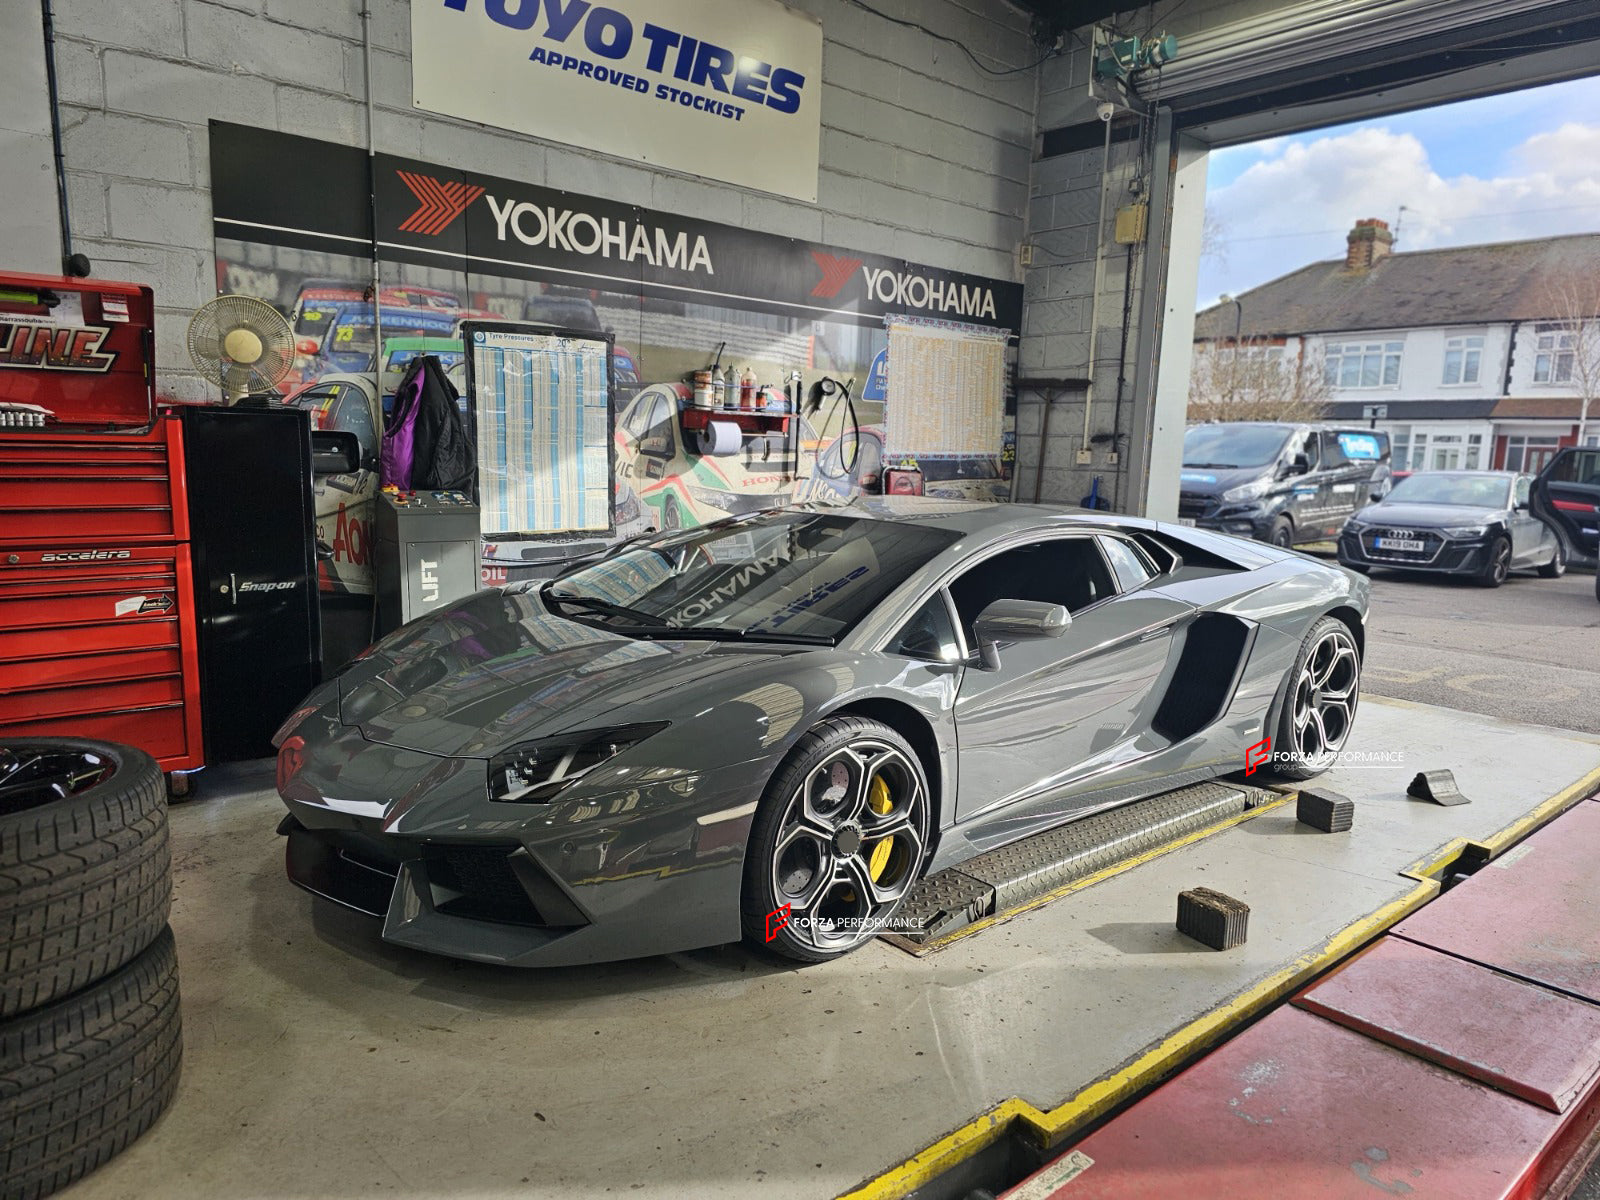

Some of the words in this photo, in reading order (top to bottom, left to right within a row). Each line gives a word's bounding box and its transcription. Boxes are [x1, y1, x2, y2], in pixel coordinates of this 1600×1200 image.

[444, 0, 634, 60] OYO
[643, 23, 805, 114] TIRES
[529, 47, 650, 93] APPROVED
[655, 84, 745, 121] STOCKIST
[486, 195, 714, 275] YOKOHAMA
[862, 266, 997, 320] YOKOHAMA
[41, 550, 131, 562] accelera
[420, 558, 439, 602] LIFT
[239, 580, 297, 593] Snap-on
